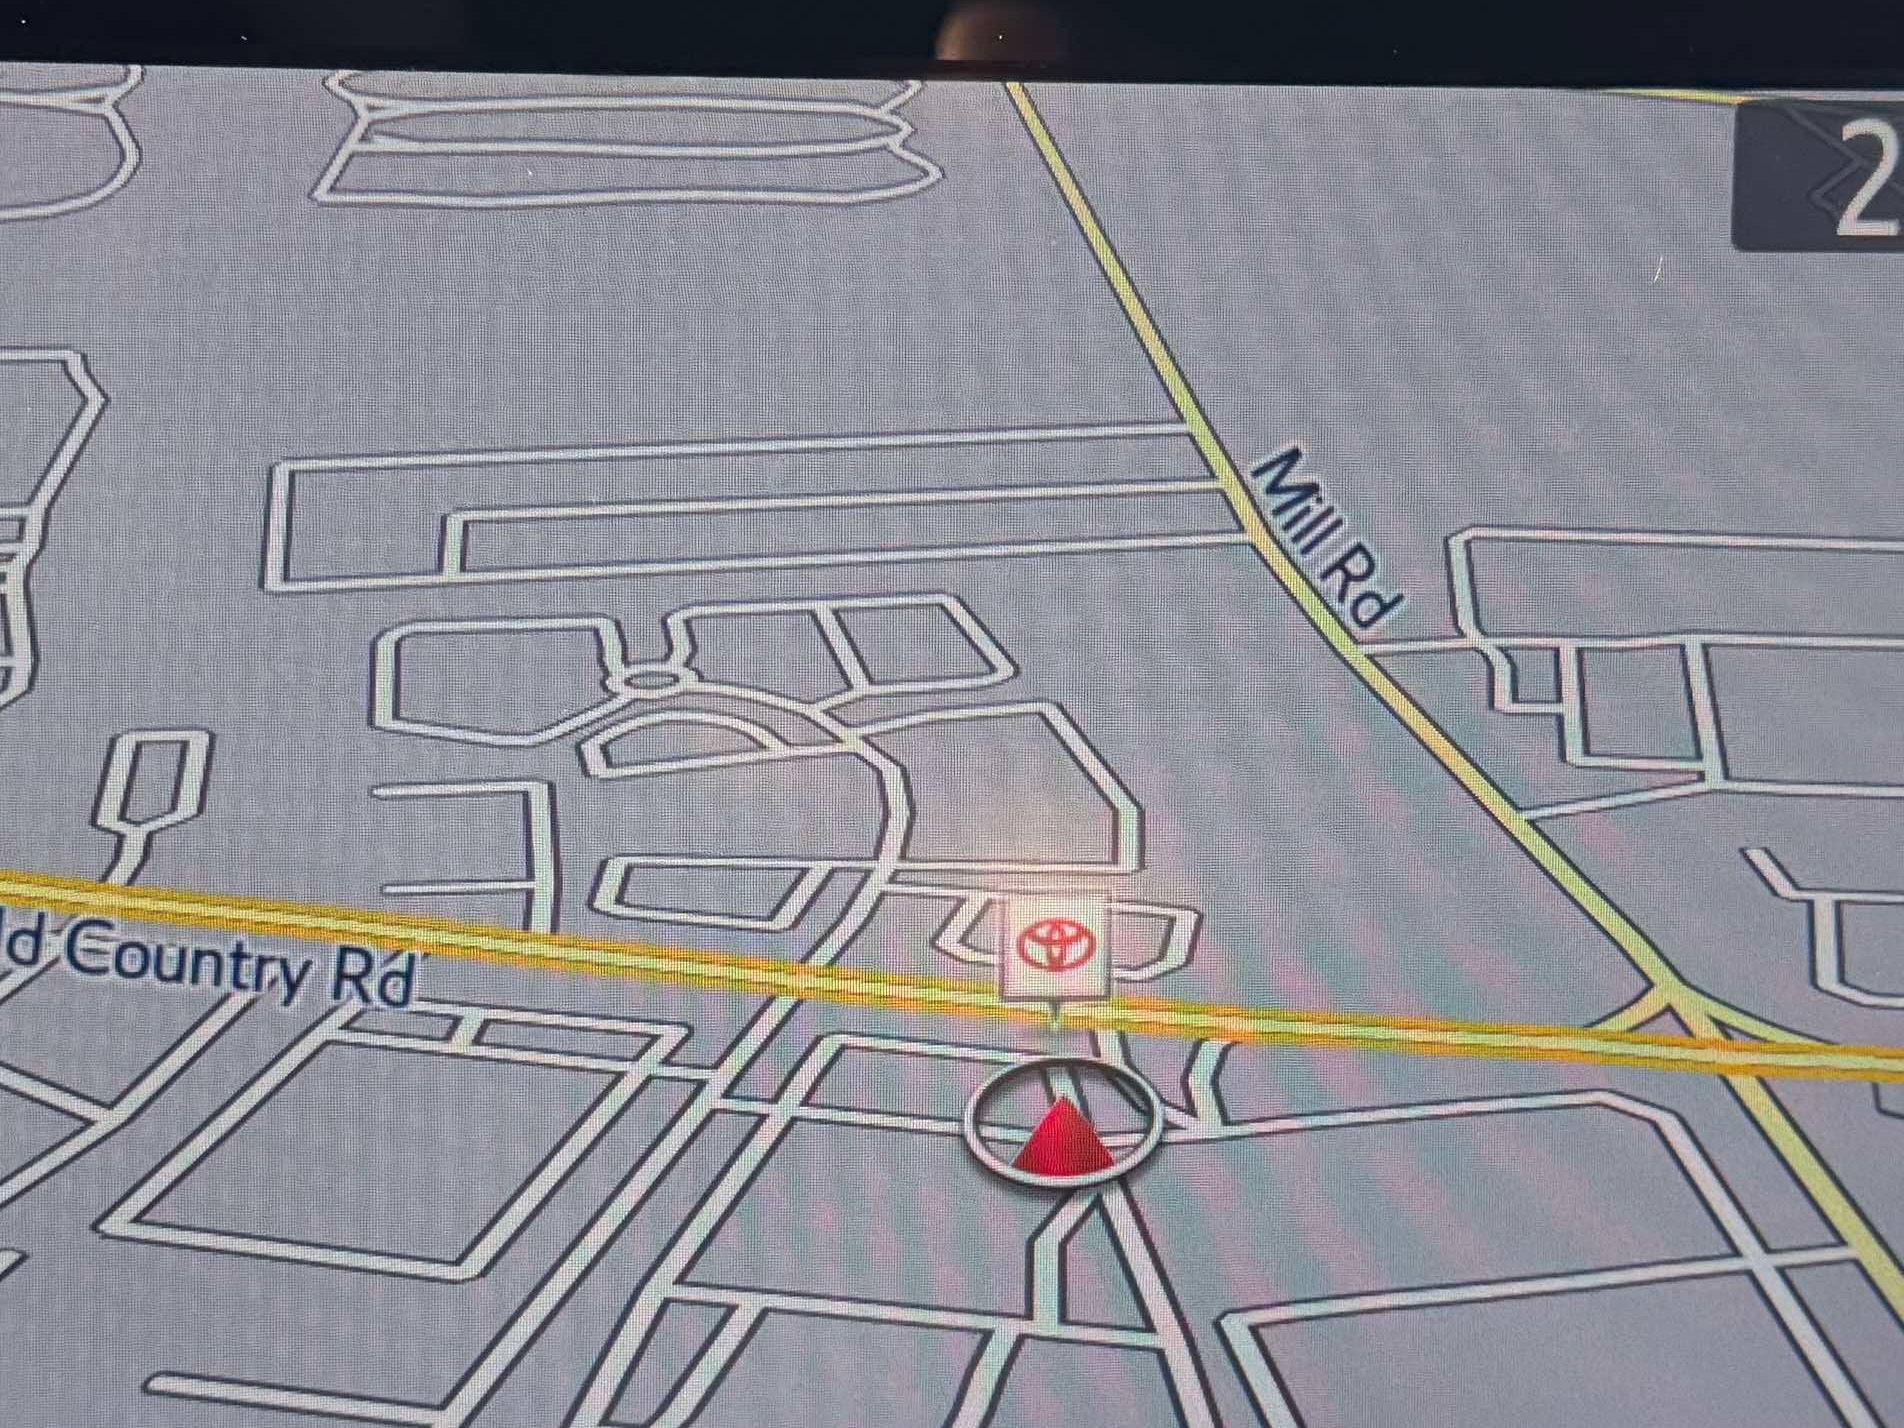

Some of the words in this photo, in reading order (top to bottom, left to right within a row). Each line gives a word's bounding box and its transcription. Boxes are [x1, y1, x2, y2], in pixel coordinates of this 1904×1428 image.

[1251, 446, 1343, 556] Mill
[1320, 541, 1405, 629] Rd
[65, 917, 313, 1006] Country
[332, 945, 417, 1008] Rd
